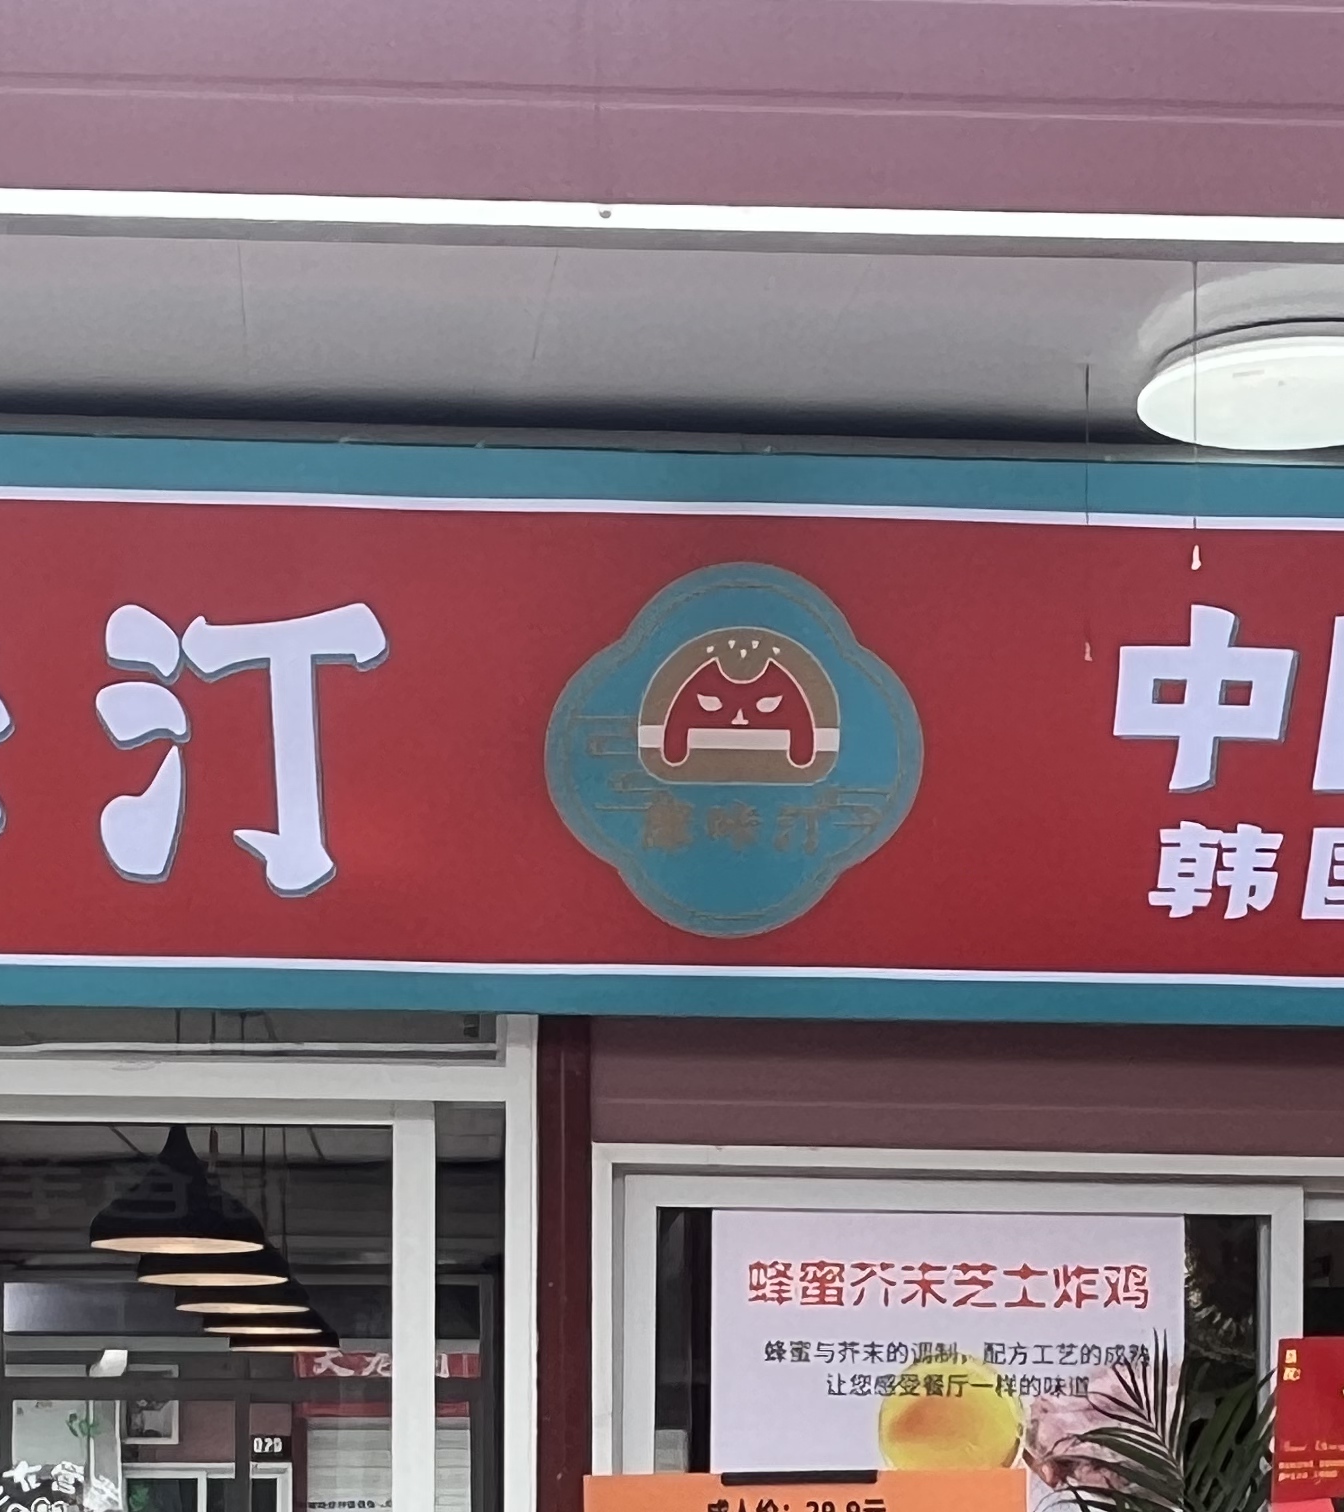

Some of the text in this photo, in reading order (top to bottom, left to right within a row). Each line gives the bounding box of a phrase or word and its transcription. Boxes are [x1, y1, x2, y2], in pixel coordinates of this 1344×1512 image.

[748, 1261, 1149, 1310] 蜂蜜芥末芝士炸鸡
